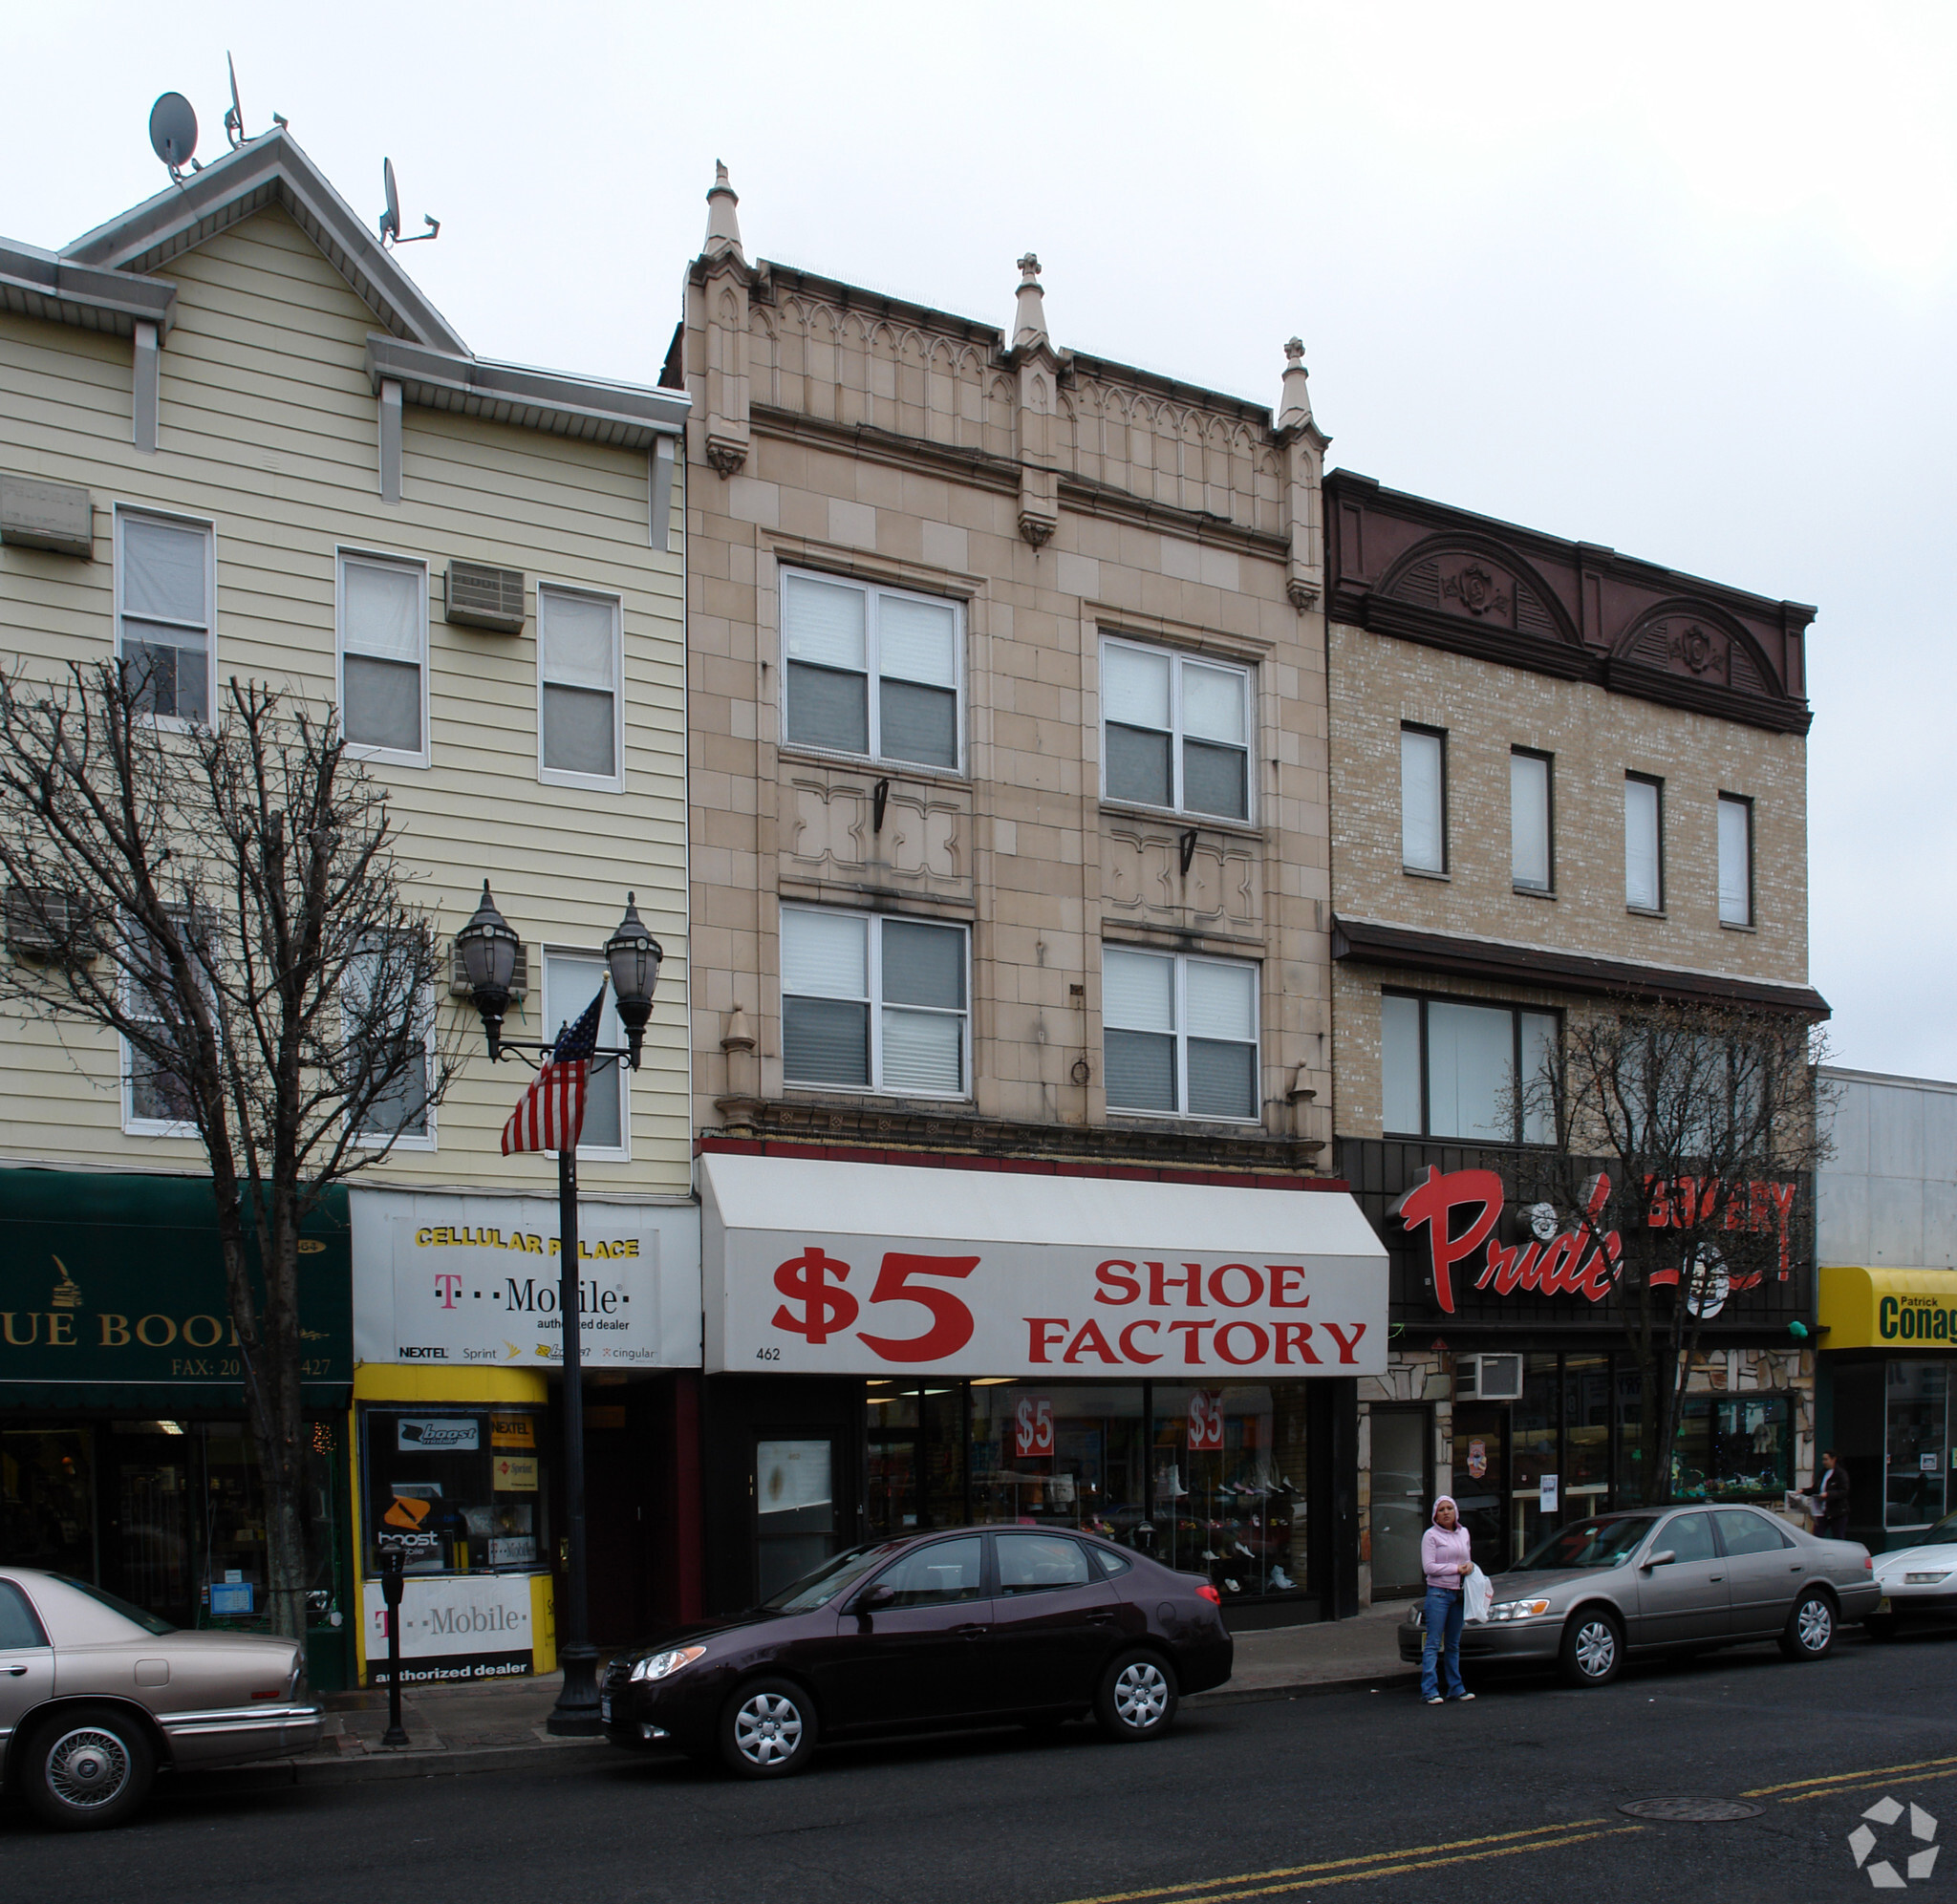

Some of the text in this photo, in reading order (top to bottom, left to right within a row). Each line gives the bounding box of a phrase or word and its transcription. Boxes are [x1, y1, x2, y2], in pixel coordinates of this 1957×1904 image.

[414, 1227, 639, 1260] CELLULAR PLACE
[1399, 1163, 1623, 1313] Pride
[1093, 1259, 1310, 1309] SHOE
[505, 1277, 617, 1315] Moile
[771, 1247, 980, 1362] $5
[1901, 1295, 1938, 1307] Patrick
[537, 1318, 630, 1330] authed dealer
[1022, 1316, 1367, 1365] FACTORY
[399, 1347, 448, 1358] NEXTEL
[463, 1347, 497, 1360] Sprint
[550, 1344, 591, 1358] bst
[613, 1347, 655, 1360] cingular
[755, 1347, 781, 1361] 462
[172, 1358, 213, 1376] FAX:
[300, 1358, 331, 1376] 427
[491, 1421, 529, 1435] NEXTEL
[1017, 1397, 1052, 1454] $5
[1190, 1394, 1222, 1447] $5
[422, 1423, 477, 1440] boost
[431, 1604, 519, 1636] Mobile
[376, 1662, 527, 1683] athorized dealer
